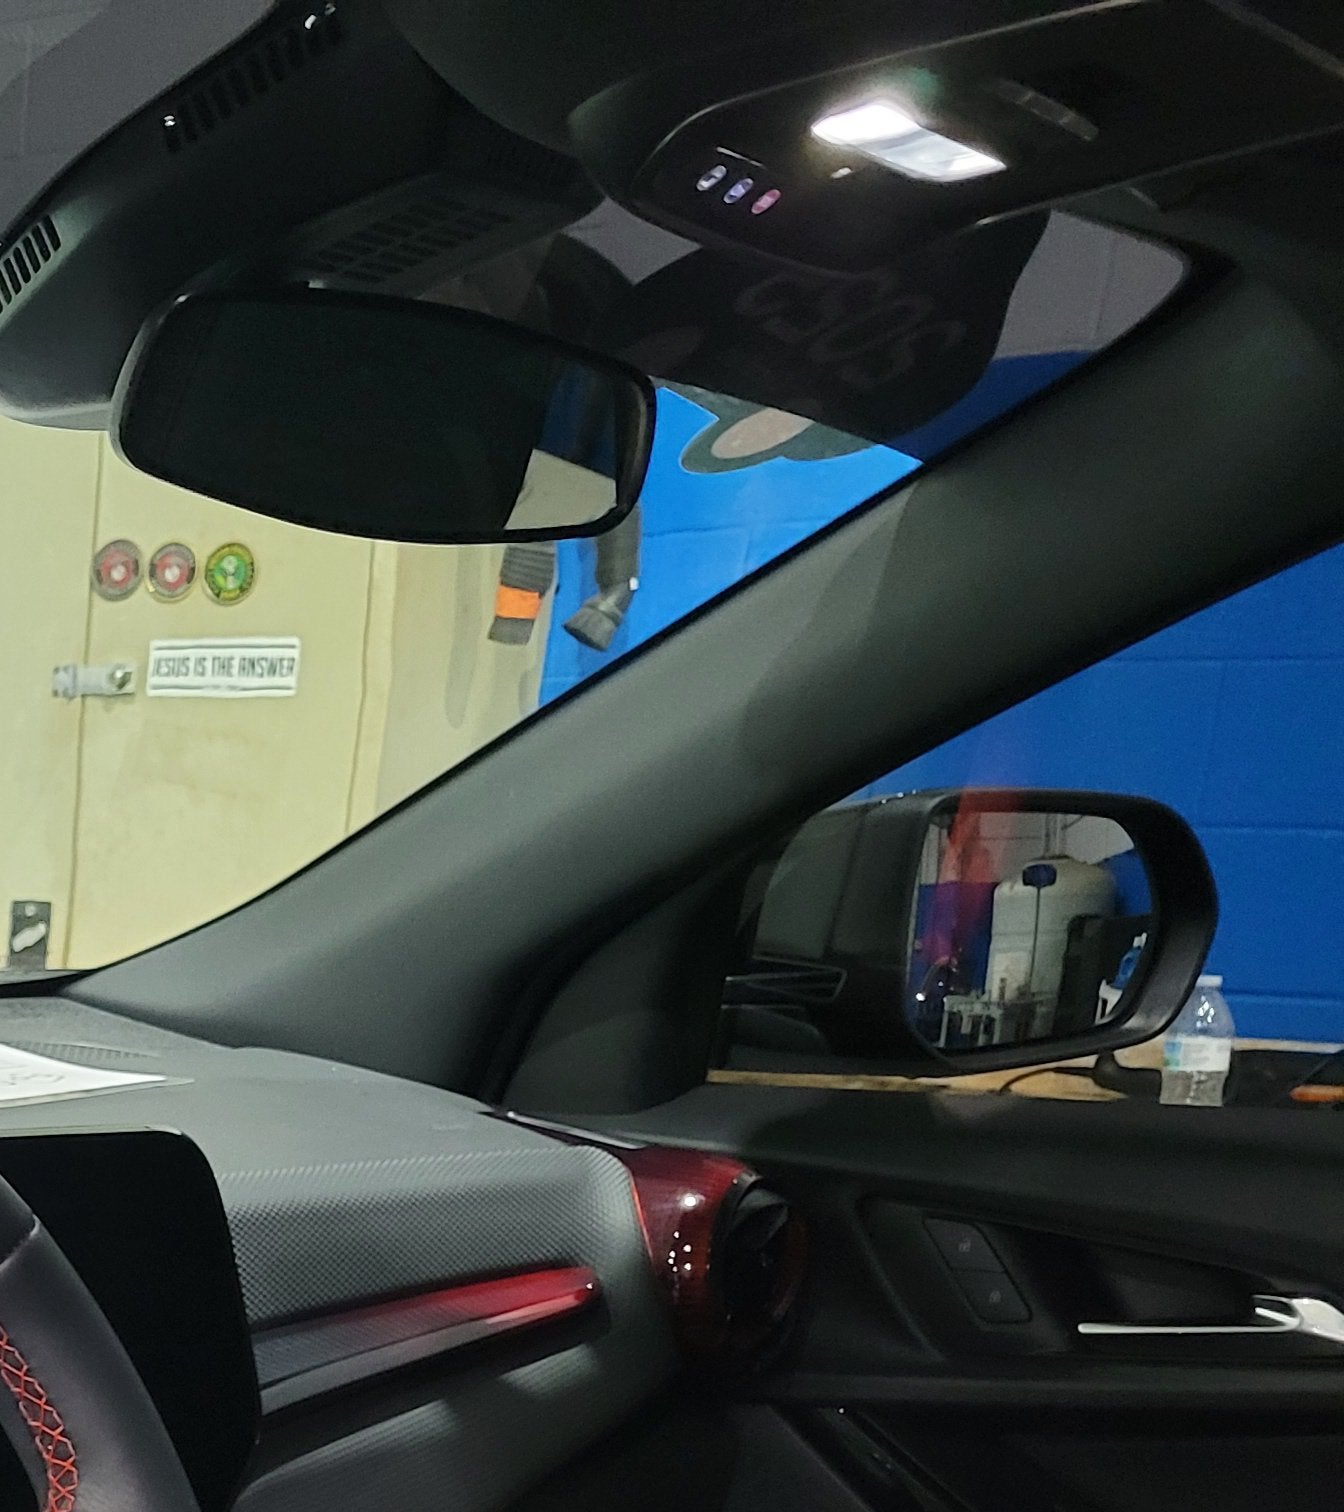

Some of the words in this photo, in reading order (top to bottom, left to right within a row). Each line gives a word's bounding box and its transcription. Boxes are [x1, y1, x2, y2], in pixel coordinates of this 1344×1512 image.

[152, 656, 190, 677] JESUS
[193, 656, 206, 677] IS
[211, 656, 234, 677] THE
[238, 656, 296, 678] ANSWER
